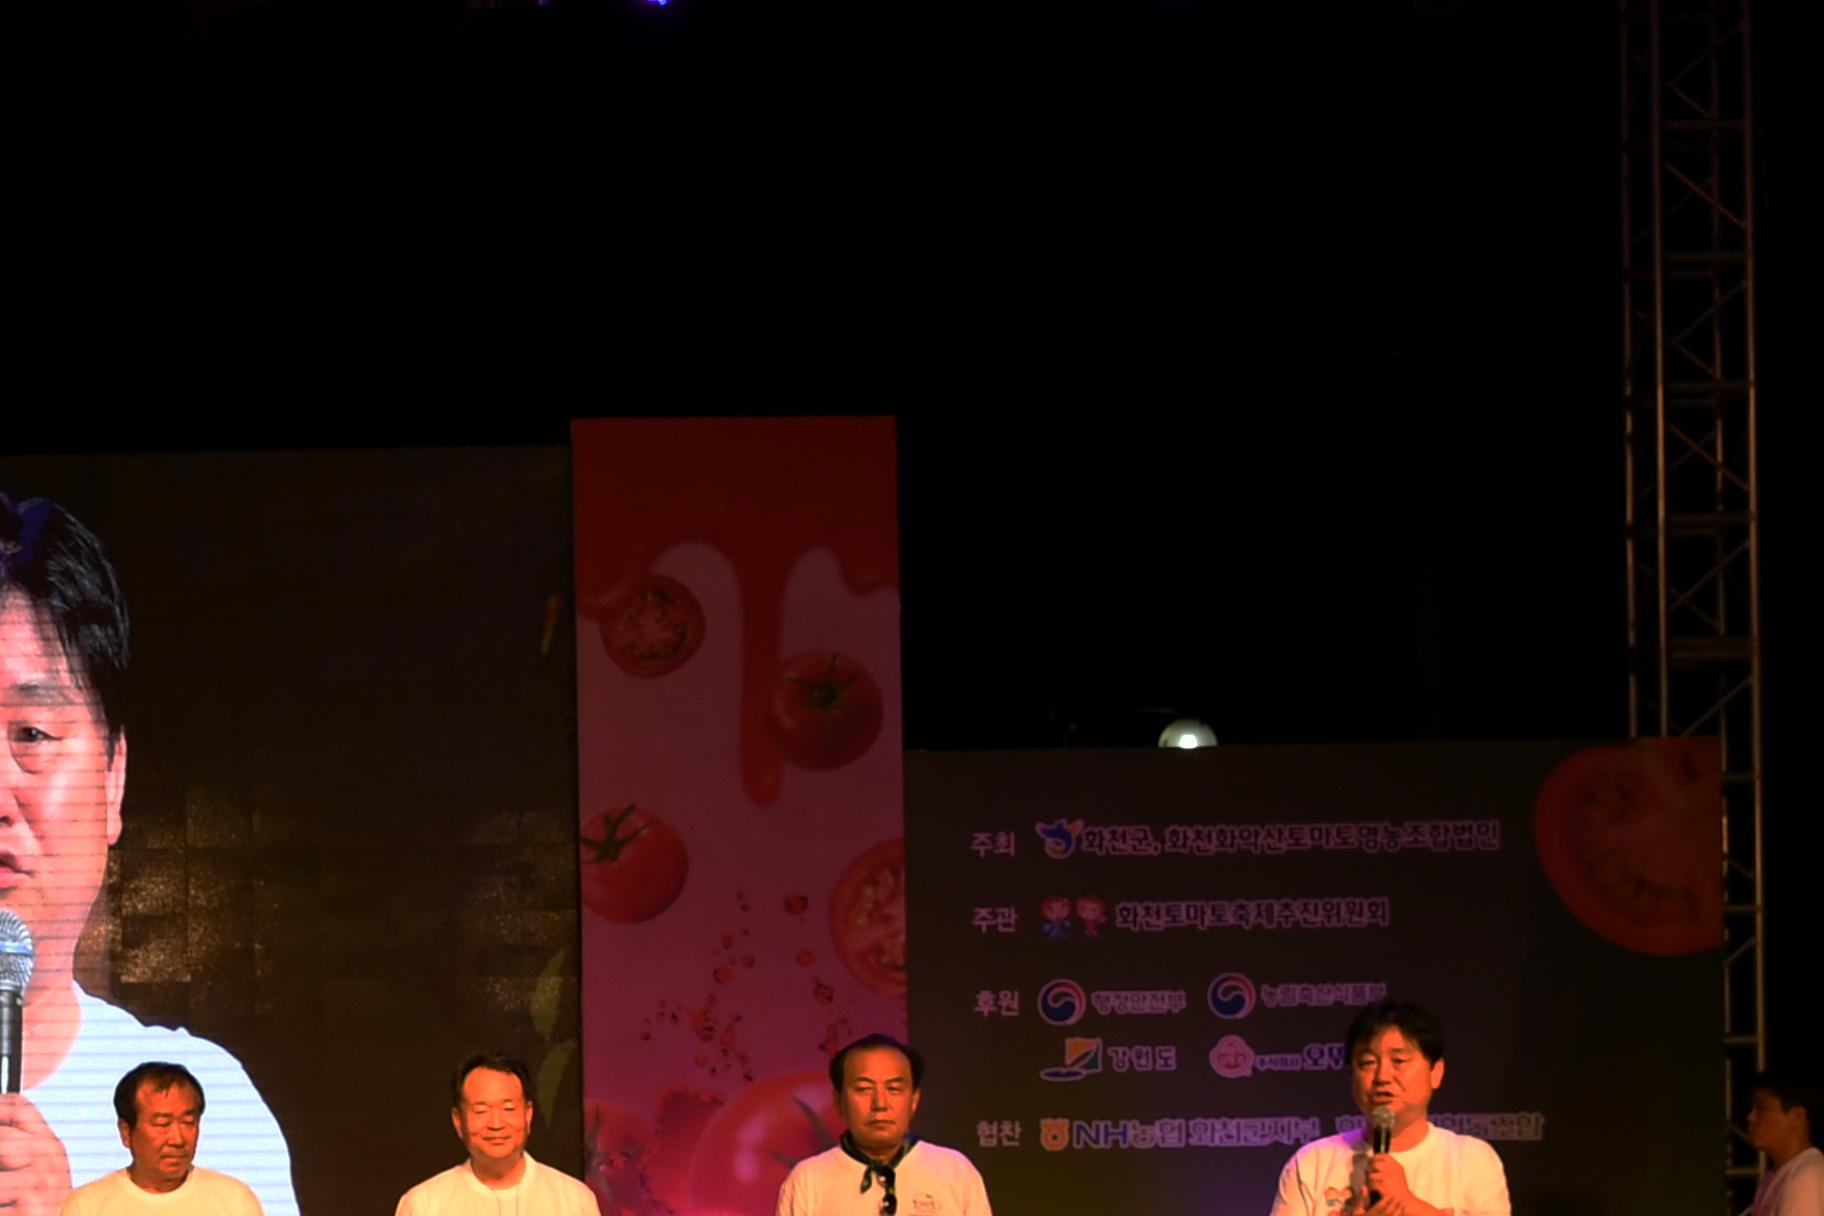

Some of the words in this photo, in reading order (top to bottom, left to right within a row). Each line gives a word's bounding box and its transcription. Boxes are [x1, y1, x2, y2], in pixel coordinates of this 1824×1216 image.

[970, 831, 1016, 858] 주최
[1082, 826, 1160, 855] 화천군,
[1165, 820, 1502, 857] 화천화악산토마토영농조합법인
[971, 906, 1018, 933] 주관
[1115, 898, 1390, 932] 화천토마토축제추진위원회
[974, 990, 1019, 1017] 후원
[1108, 1047, 1176, 1071] 강원도
[976, 1121, 1022, 1147] 협찬
[1073, 1119, 1185, 1149] NH농협
